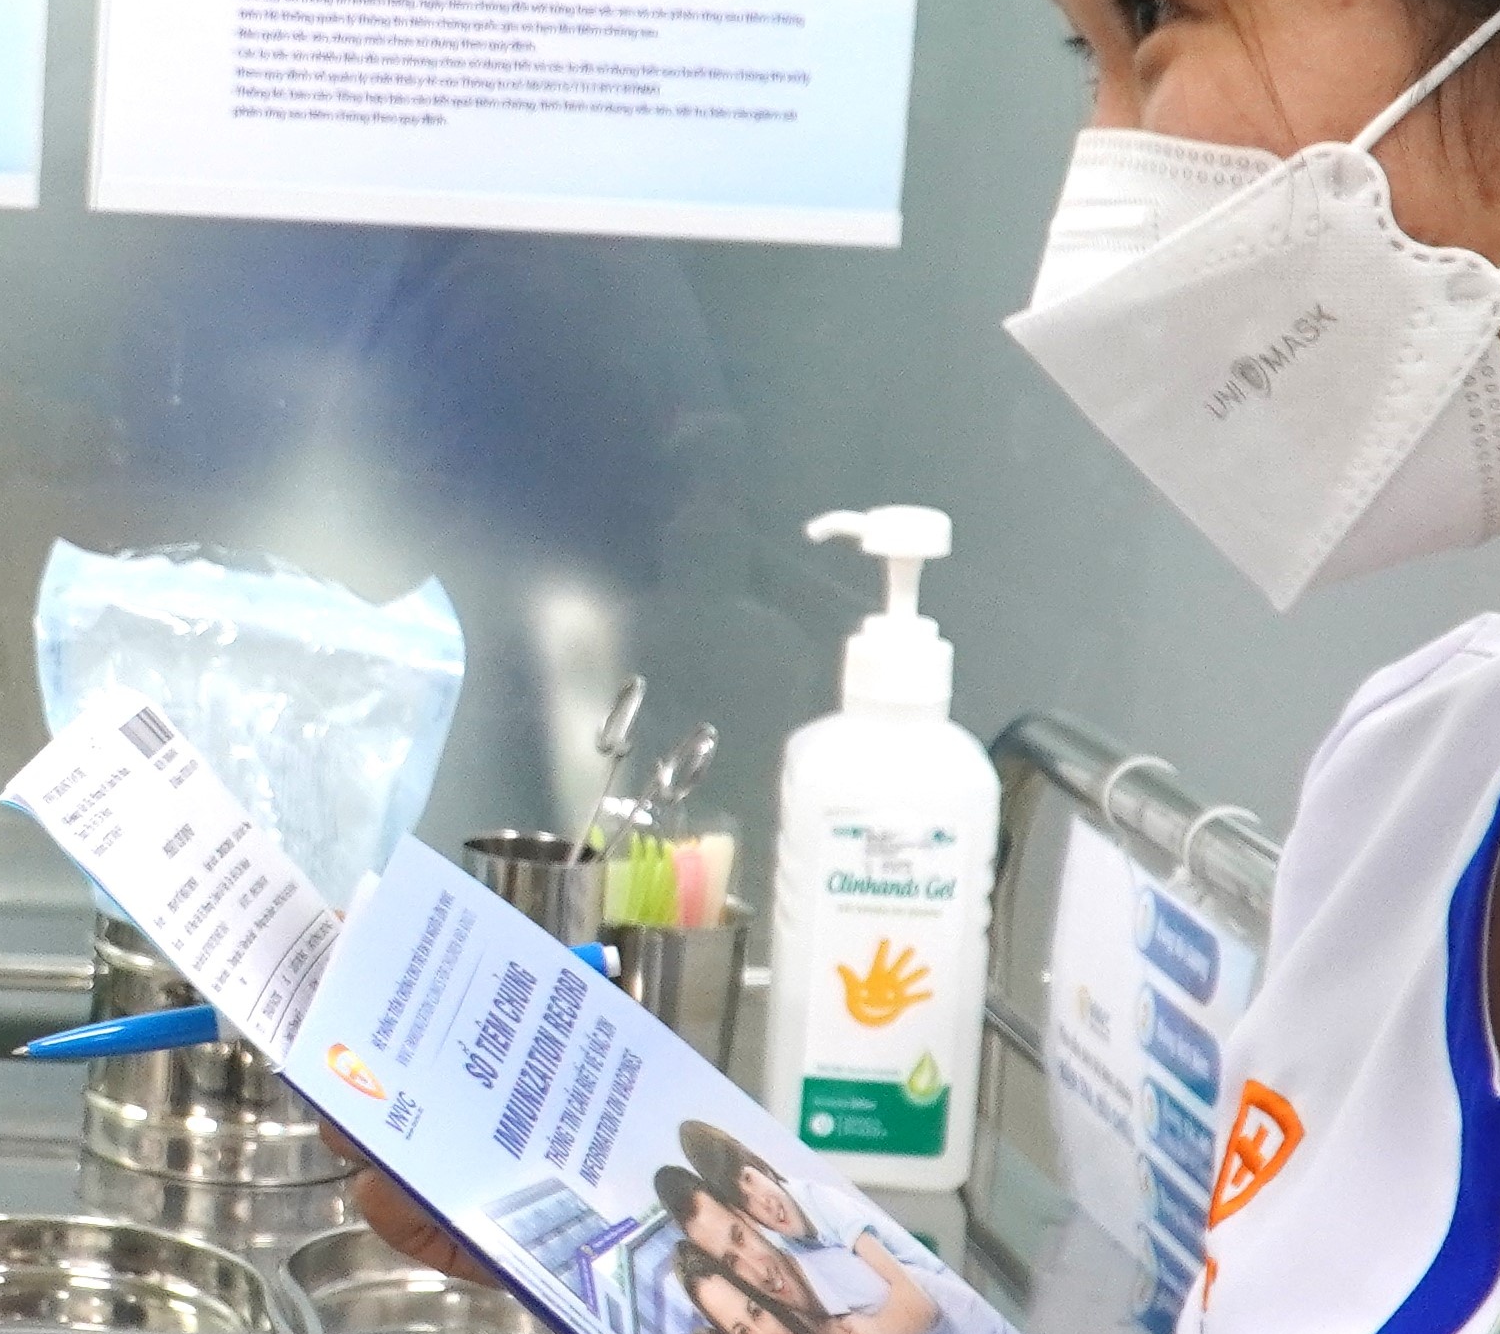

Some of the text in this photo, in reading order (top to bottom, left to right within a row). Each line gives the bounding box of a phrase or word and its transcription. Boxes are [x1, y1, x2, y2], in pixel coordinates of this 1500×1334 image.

[827, 870, 957, 901] Clinhands Gel
[458, 961, 538, 1090] SỔ TIÊM CHỦNG
[493, 967, 588, 1161] IMMUNIZATION RECORD
[385, 1091, 417, 1133] VNVC
[559, 1107, 584, 1134] TIN
[564, 1086, 591, 1117] CẦN
[579, 1047, 643, 1189] INFORMATION ON VACCINES
[544, 1128, 575, 1170] THÔNG
